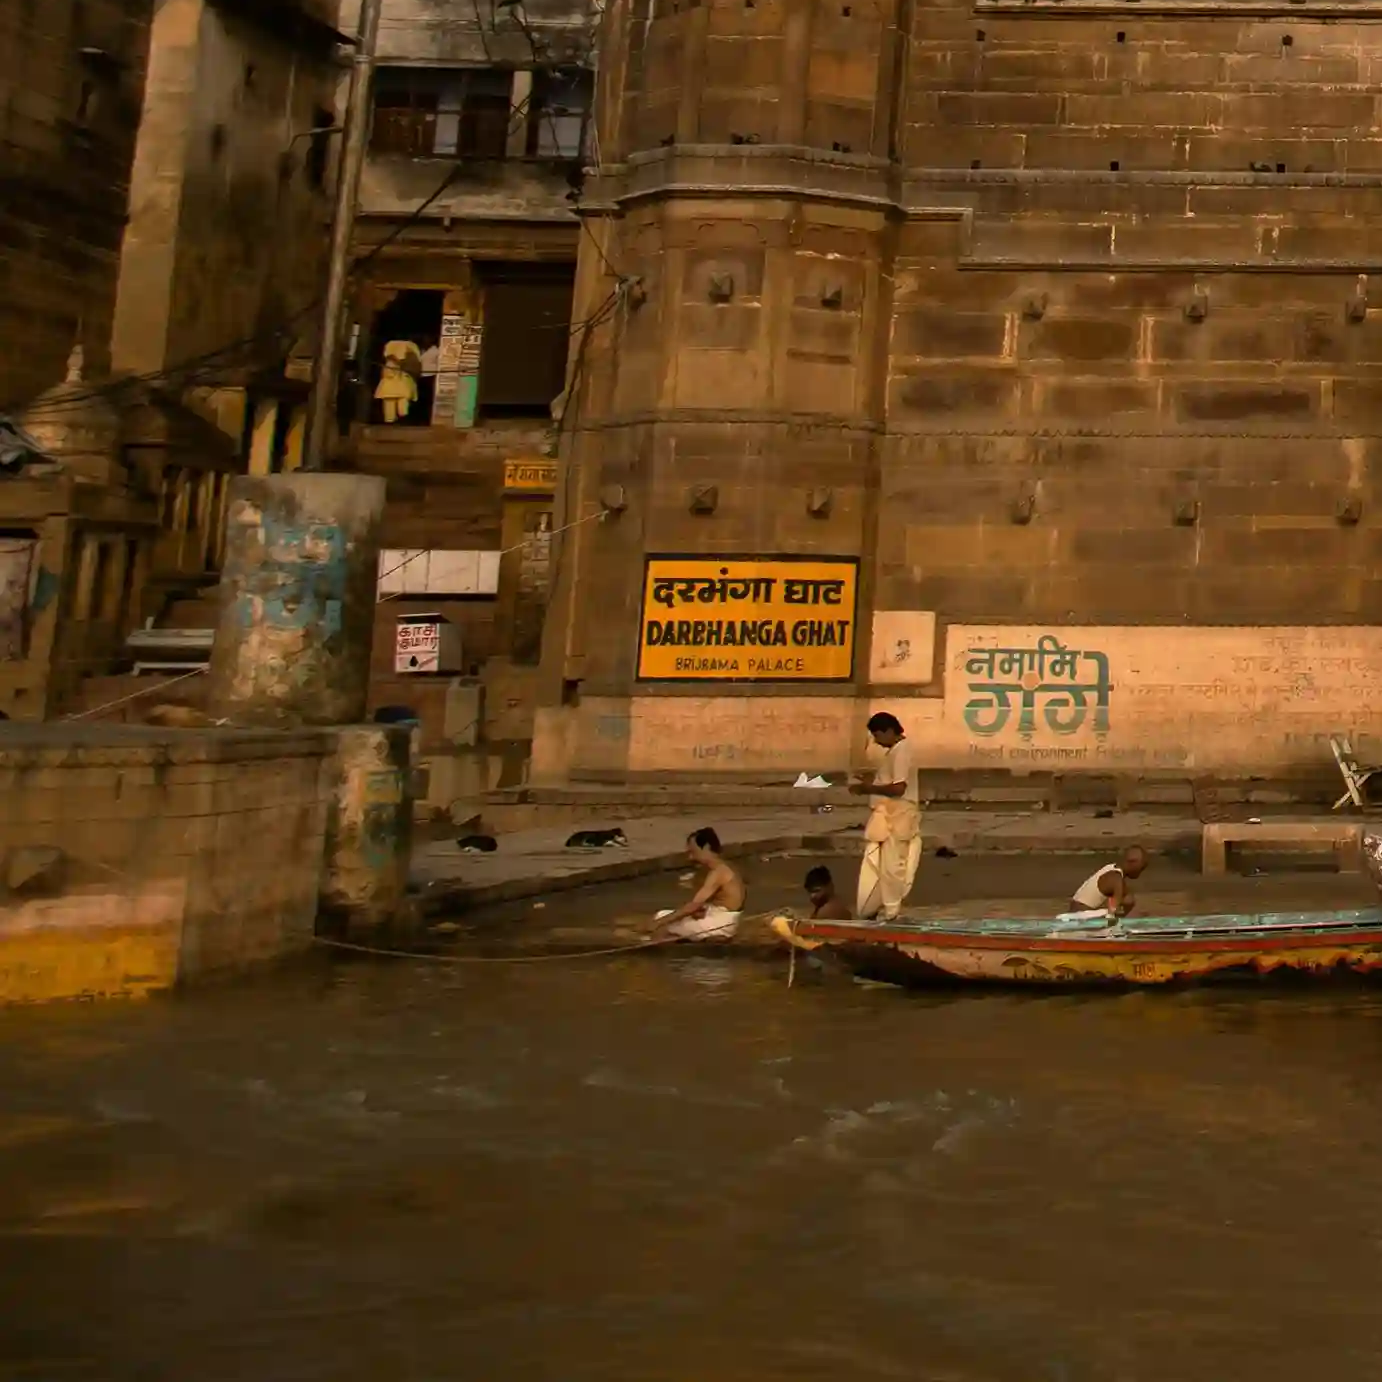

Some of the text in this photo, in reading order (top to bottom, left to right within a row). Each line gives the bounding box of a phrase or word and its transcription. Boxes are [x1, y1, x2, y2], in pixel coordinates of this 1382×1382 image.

[653, 567, 846, 608] दरभंगा घाट
[646, 620, 850, 647] DARBHANGA GHAT
[748, 657, 805, 672] PALACE
[964, 634, 1082, 682] नमामि
